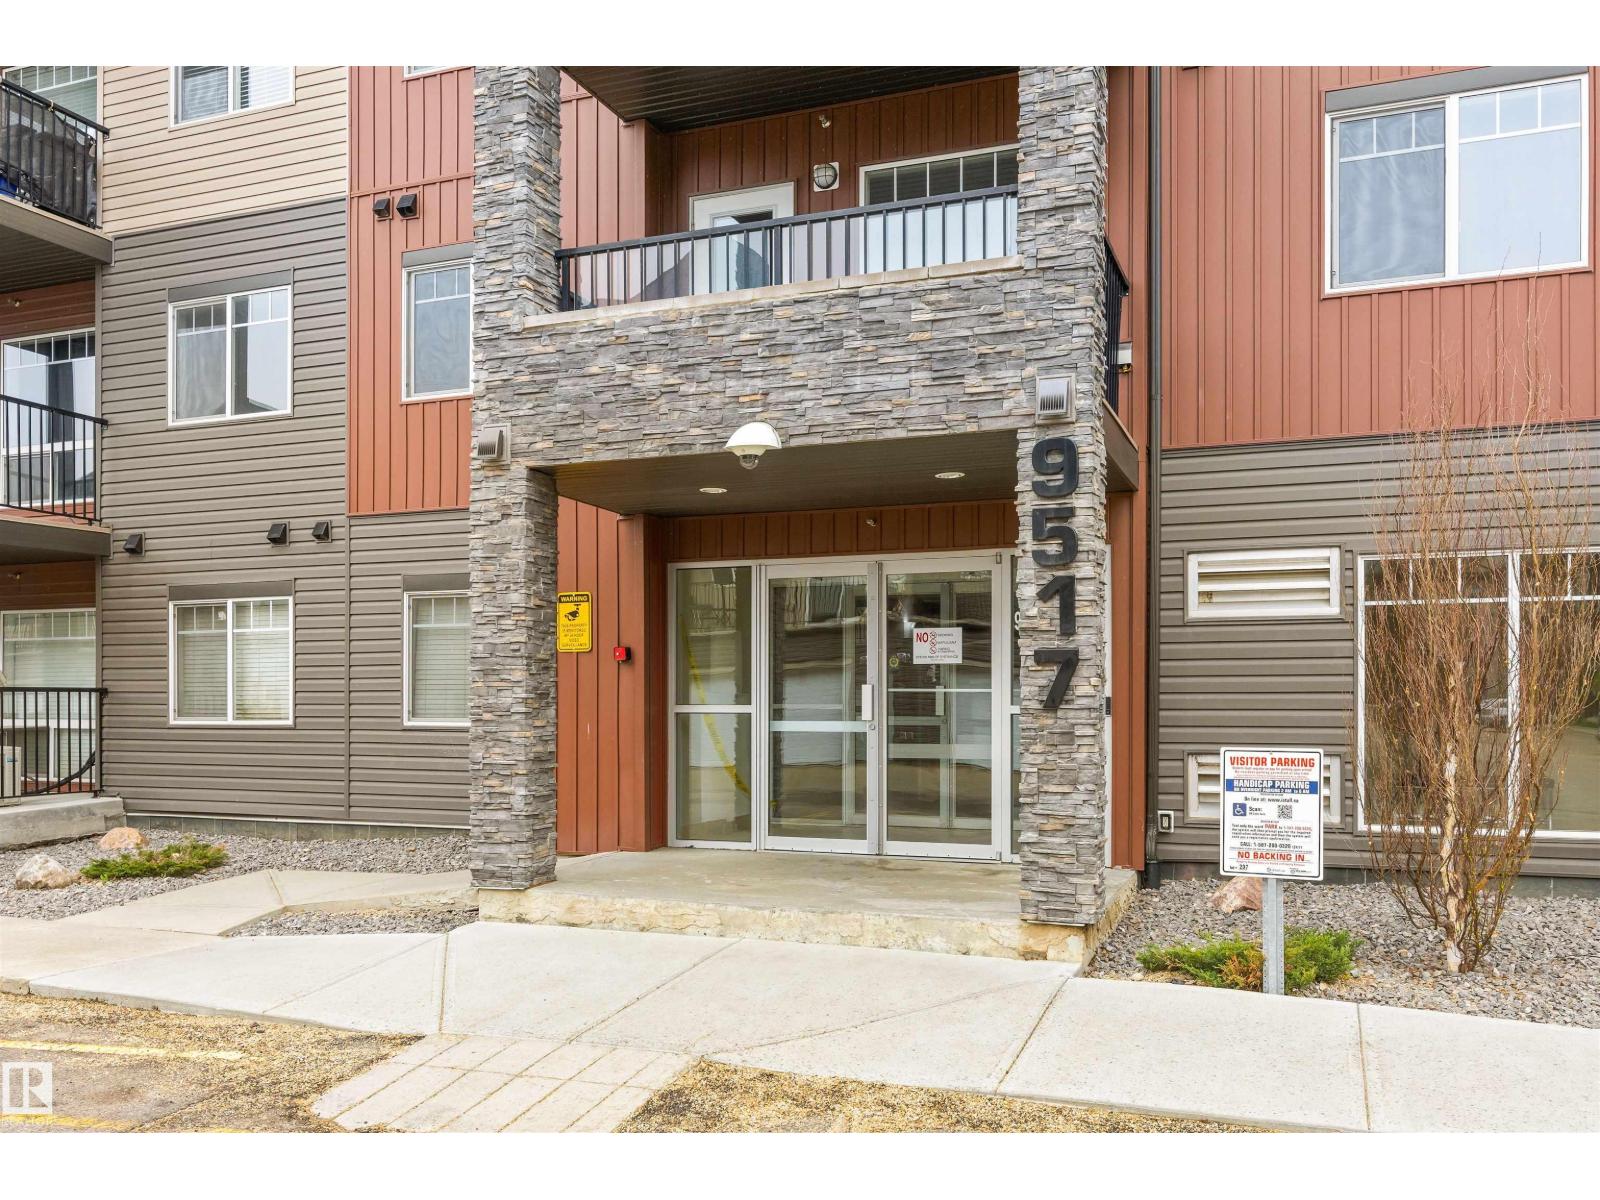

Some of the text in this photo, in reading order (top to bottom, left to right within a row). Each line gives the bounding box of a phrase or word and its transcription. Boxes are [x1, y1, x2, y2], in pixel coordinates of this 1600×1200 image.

[1032, 437, 1079, 709] 9517
[916, 632, 928, 642] NO
[1230, 756, 1315, 768] VISITOR PARKING
[1234, 780, 1310, 789] HANDICAP PARKING
[1253, 852, 1292, 860] BACKING
